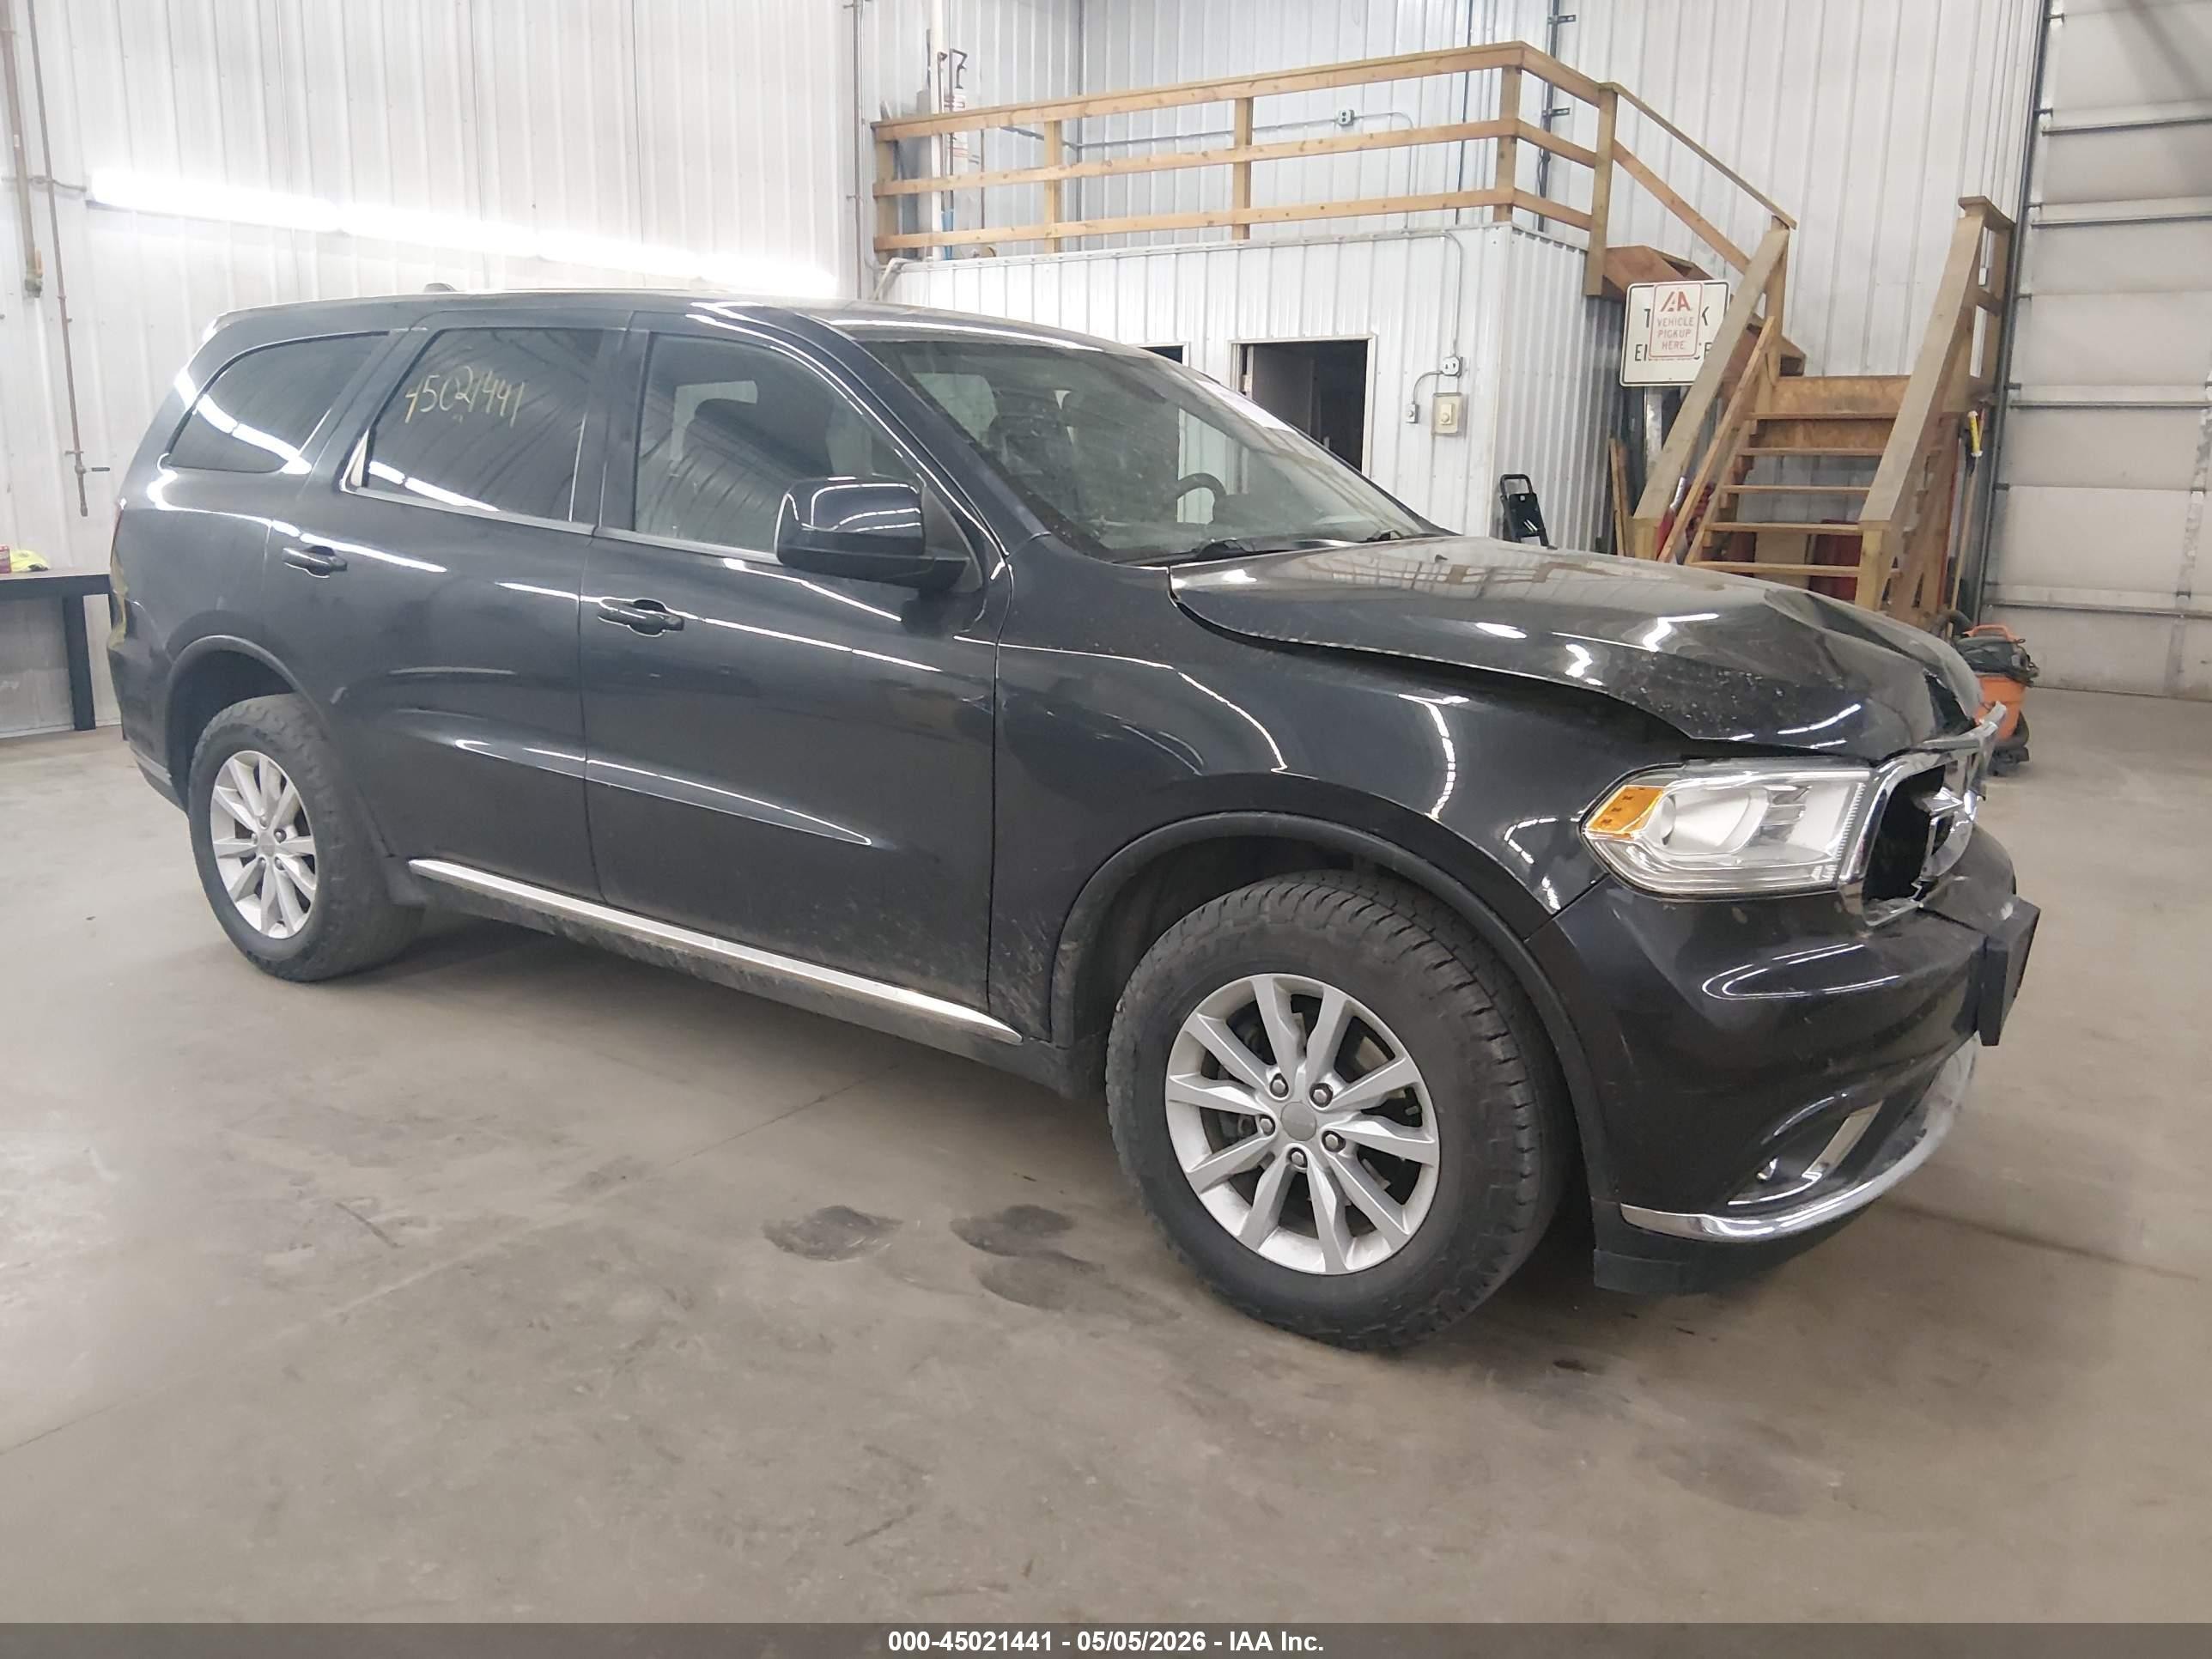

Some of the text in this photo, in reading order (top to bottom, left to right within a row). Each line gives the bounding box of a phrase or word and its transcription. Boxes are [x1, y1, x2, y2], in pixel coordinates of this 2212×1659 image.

[1656, 316, 1694, 328] VEHICLE
[1656, 329, 1692, 339] PICKUP
[1662, 340, 1685, 350] HERE
